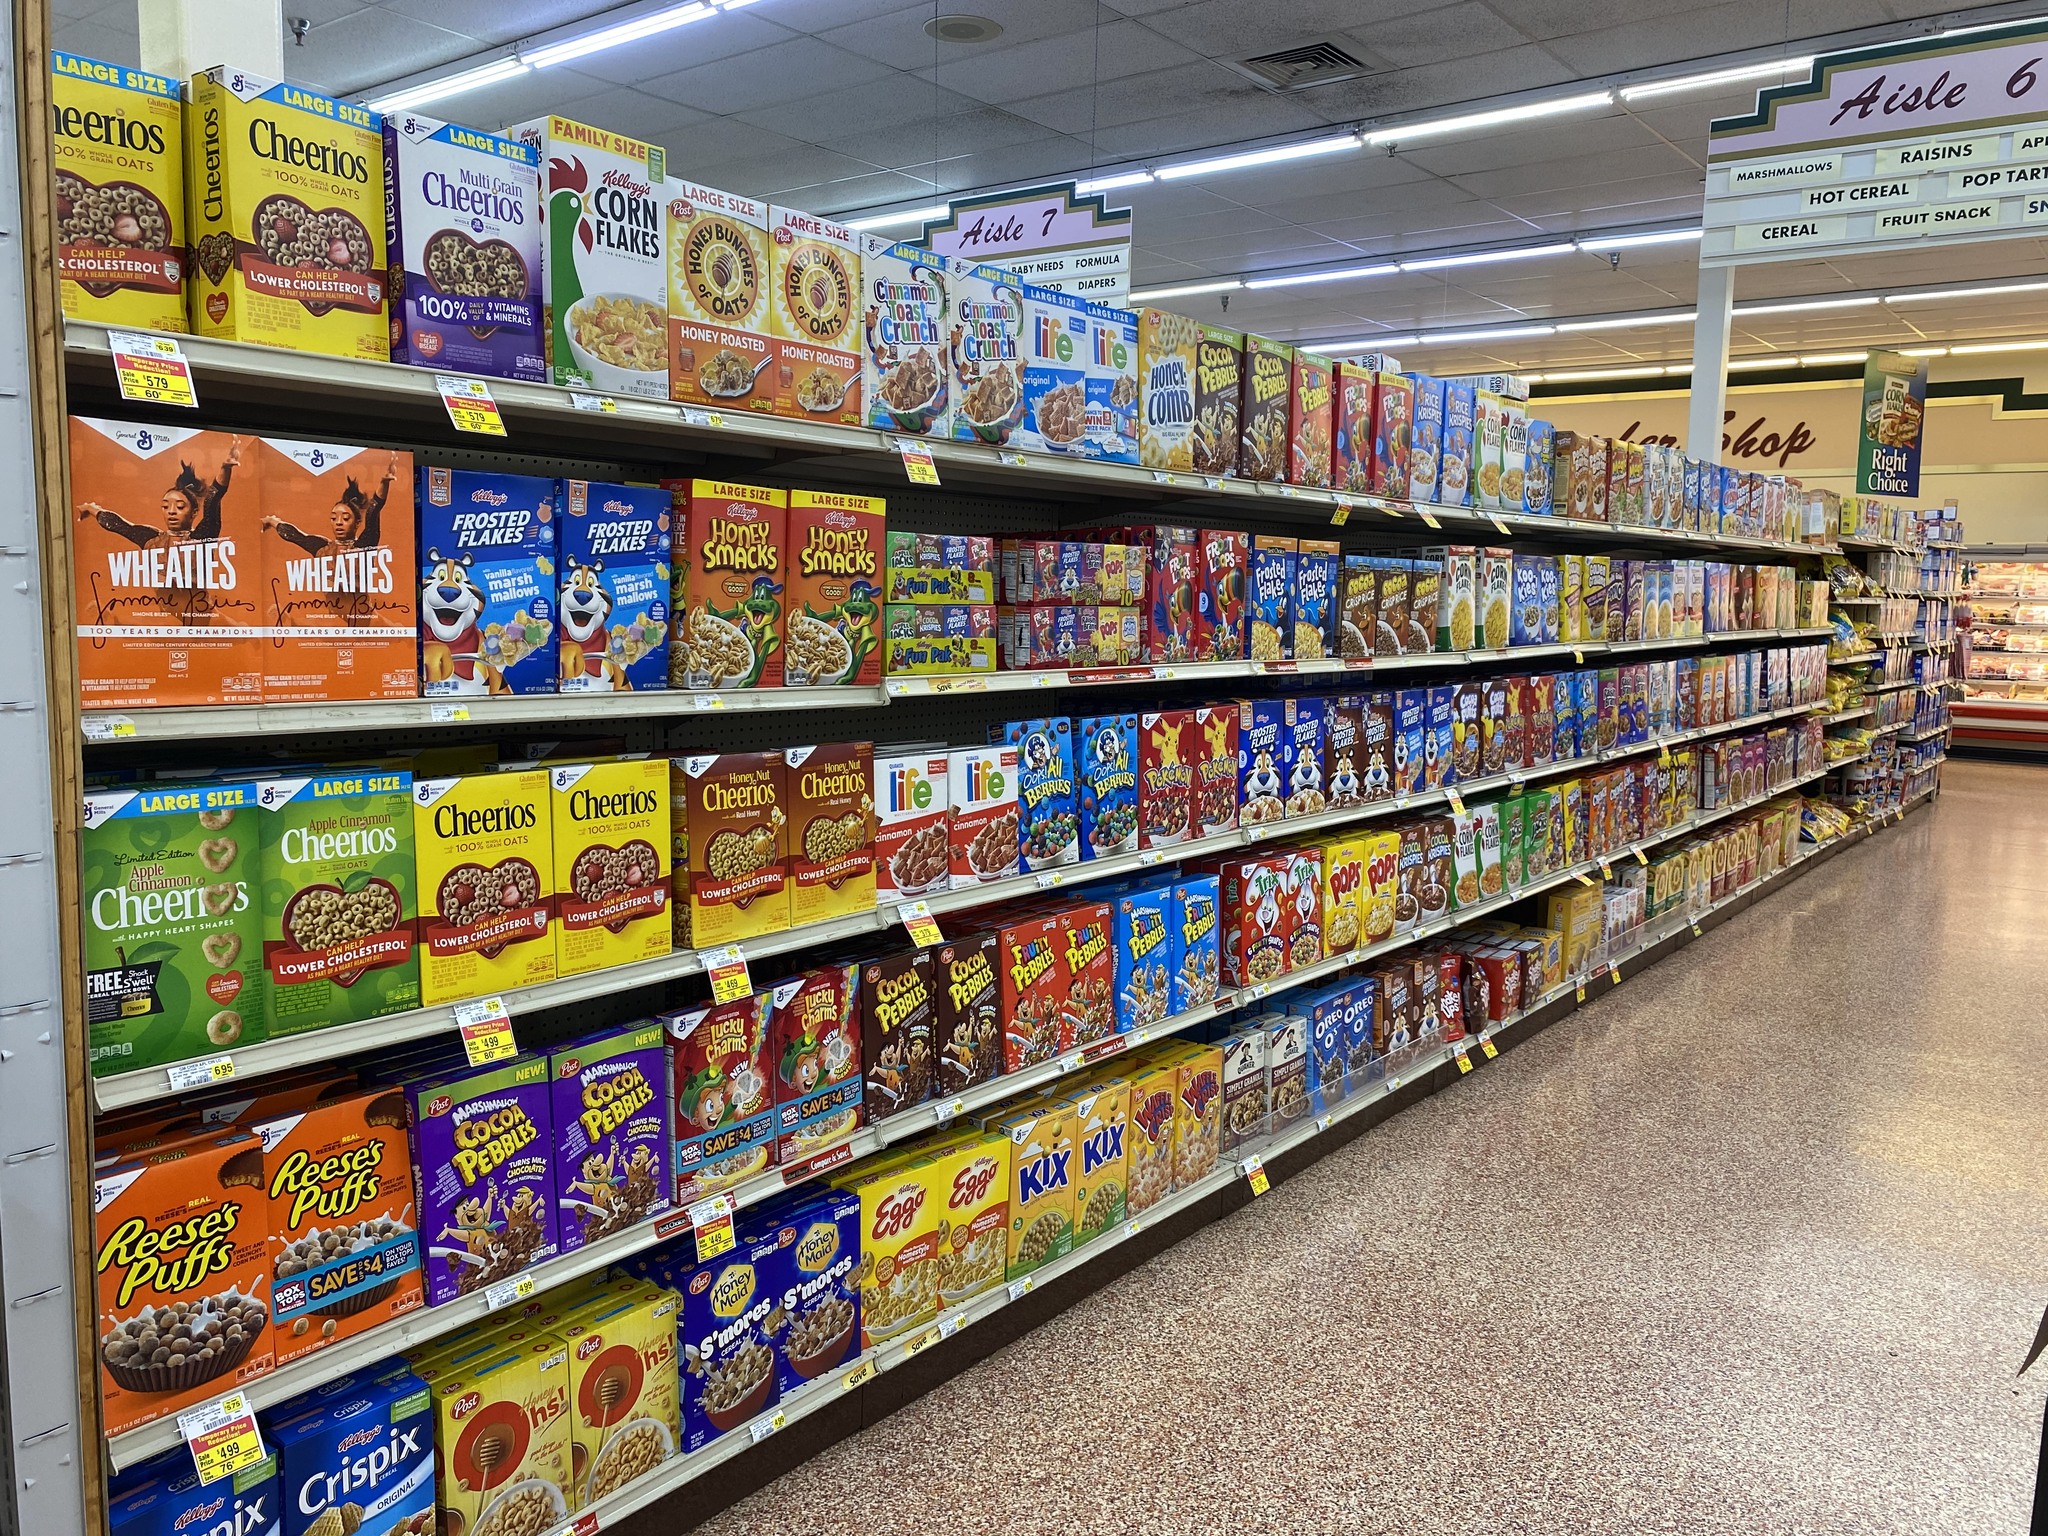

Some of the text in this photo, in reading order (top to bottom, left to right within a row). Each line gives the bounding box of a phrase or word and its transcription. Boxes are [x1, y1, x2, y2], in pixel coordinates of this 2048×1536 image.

[56, 55, 168, 94] LARGE SIZE
[1830, 57, 2043, 126] Aisle 6
[249, 118, 368, 184] Cheerios
[450, 132, 526, 161] LARGE SIZE
[554, 121, 645, 159] FAMILY SIZE
[2021, 136, 2048, 149] AP
[117, 156, 154, 172] OATS
[204, 108, 222, 222] Cheerios
[1901, 144, 1972, 164] RAISINS
[1737, 161, 1832, 182] MARSHMALLOWS
[1963, 172, 2000, 188] POP
[459, 168, 522, 198] Multi Grain
[1809, 183, 1909, 205] HOT CEREAL
[595, 187, 657, 231] CORN
[672, 201, 691, 215] Post
[1882, 206, 1991, 228] FRUIT SNACK
[597, 221, 660, 258] FLAKES
[959, 209, 1058, 249] Aisle 7
[1762, 224, 1818, 240] CEREAL
[71, 249, 125, 259] CAN HELP
[1076, 255, 1119, 268] FORMULA
[68, 259, 160, 274] CHOLESTEROL
[296, 271, 338, 281] CAN HELP
[1012, 260, 1064, 275] BABY NEEDS
[250, 270, 364, 295] LOWER CHOLESTEROL
[1078, 278, 1116, 290] DIAPERS
[489, 301, 529, 316] 9 VITAMINS
[1030, 289, 1076, 307] LARGE SIZE
[681, 326, 765, 352] HONEY ROASTED
[883, 320, 939, 345] Crunch
[1035, 315, 1073, 362] life
[1208, 331, 1233, 343] LARGE SIZE
[782, 345, 854, 370] HONEY ROASTED
[965, 337, 1016, 362] Crunch
[1093, 327, 1127, 370] life
[1200, 344, 1233, 366] COCOA
[1023, 376, 1050, 386] original
[1425, 393, 1439, 407] RICE
[1418, 404, 1442, 425] KRISPIES
[1872, 448, 1908, 478] Right
[714, 484, 771, 501] LARGE SIZE
[1868, 471, 1908, 493] Choice
[471, 490, 508, 504] Kellogg's
[603, 501, 633, 515] Kellogg's
[452, 511, 531, 531] FROSTED
[457, 527, 524, 547] FLAKES
[591, 536, 647, 554] FLAKES
[108, 541, 237, 590] WHEATIES
[703, 543, 777, 571] SMACKS
[801, 548, 876, 575] SMACKS
[286, 549, 393, 593] WHEATIES
[1256, 558, 1285, 581] Frosted
[1490, 565, 1507, 583] CORN
[489, 575, 533, 590] marsh
[906, 577, 950, 594] Fun Pak
[1259, 579, 1284, 601] Flakes
[1120, 589, 1132, 607] 10
[905, 647, 951, 663] Fun Pak
[937, 683, 952, 692] Save
[1249, 724, 1277, 740] FROSTED
[1293, 719, 1318, 737] FROSTED
[729, 770, 770, 784] Honey Nut
[824, 760, 860, 774] Honey Nut
[1025, 780, 1071, 808] BERRIES
[1094, 772, 1134, 799] BERRIES
[570, 789, 657, 821] Cheerios
[309, 814, 391, 833] Apple Cinnamon
[434, 803, 536, 838] Cheerios
[281, 827, 397, 864] Cheerios
[456, 836, 528, 853] 100% OATS
[875, 827, 912, 843] cinnamon
[1430, 835, 1448, 847] COCOA
[1404, 842, 1421, 854] COCOA
[129, 874, 191, 892] Cinnamon
[131, 864, 164, 882] Apple
[1255, 868, 1280, 897] Trix
[1329, 860, 1362, 907] POPS
[1367, 852, 1398, 898] POPS
[568, 896, 651, 922] LOWER CHOLESTEROL
[603, 893, 630, 907] CAN HELP
[435, 918, 531, 948] LOWER CHOLESTEROL
[475, 915, 506, 931] CAN HELP
[279, 941, 406, 974] LOWER CHOLESTEROL
[326, 940, 364, 957] CAN HELP
[1065, 932, 1106, 976] PEBBLES
[1011, 945, 1055, 994] PEBBLES
[804, 988, 834, 1010] Lucky
[948, 962, 994, 1014] PEBBLES
[801, 1006, 837, 1031] Charms
[874, 986, 927, 1035] PEBBLES
[1315, 1009, 1343, 1040] OREO
[634, 1030, 661, 1047] NEW!
[822, 1029, 838, 1046] NEW
[515, 1063, 545, 1082] NEW!
[1226, 1071, 1263, 1094] SIMPLY GRANOLA
[452, 1098, 518, 1127] MARSHMALLOW
[454, 1105, 526, 1150] COCOA
[810, 1146, 850, 1171] Compare & Save!
[1083, 1123, 1126, 1177] KIX
[271, 1140, 383, 1198] Reese's
[1019, 1149, 1072, 1205] KIX
[948, 1161, 999, 1210] Eggo
[872, 1186, 927, 1242] Eggo
[98, 1204, 239, 1272] Reese's
[119, 1243, 234, 1306] Puffs
[784, 1255, 852, 1310] S'mores
[275, 1284, 300, 1301] BOX
[700, 1297, 770, 1360] S'mores
[579, 1337, 602, 1358] Post
[911, 1335, 929, 1354] Save
[849, 1367, 868, 1386] Save
[520, 1385, 556, 1413] Honey
[200, 1459, 214, 1468] Price
[298, 1424, 422, 1515] Crispix
[377, 1478, 415, 1510] ORIGINAL
